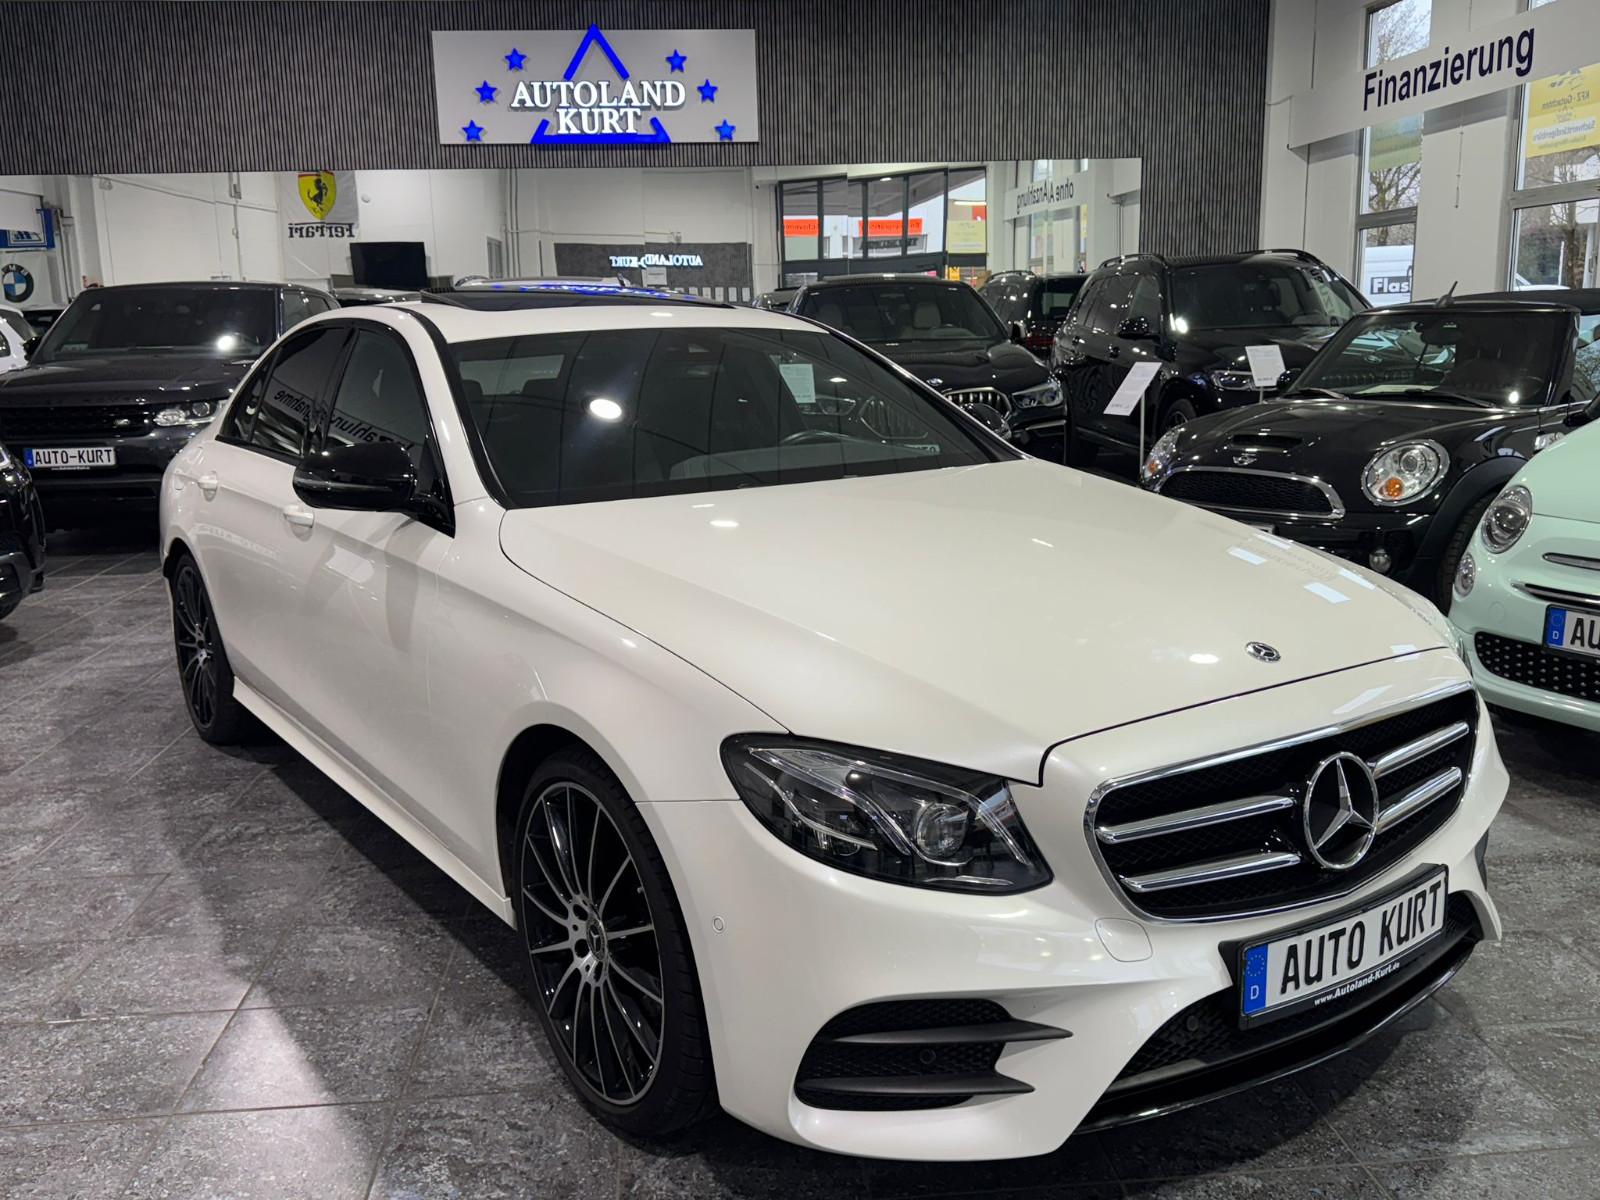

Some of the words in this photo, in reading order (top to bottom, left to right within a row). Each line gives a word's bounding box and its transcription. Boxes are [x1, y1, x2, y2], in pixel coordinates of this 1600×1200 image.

[1363, 28, 1535, 111] Finanzierung
[511, 80, 686, 108] AUTOLAND
[556, 108, 641, 135] KURT
[1373, 277, 1412, 293] Flas
[35, 449, 112, 464] AUTO-KURT
[1250, 984, 1259, 1000] D
[1280, 921, 1366, 995] AUTO
[1379, 880, 1442, 956] KURT
[1314, 961, 1401, 1006] www.Autoland-Kurt.de
